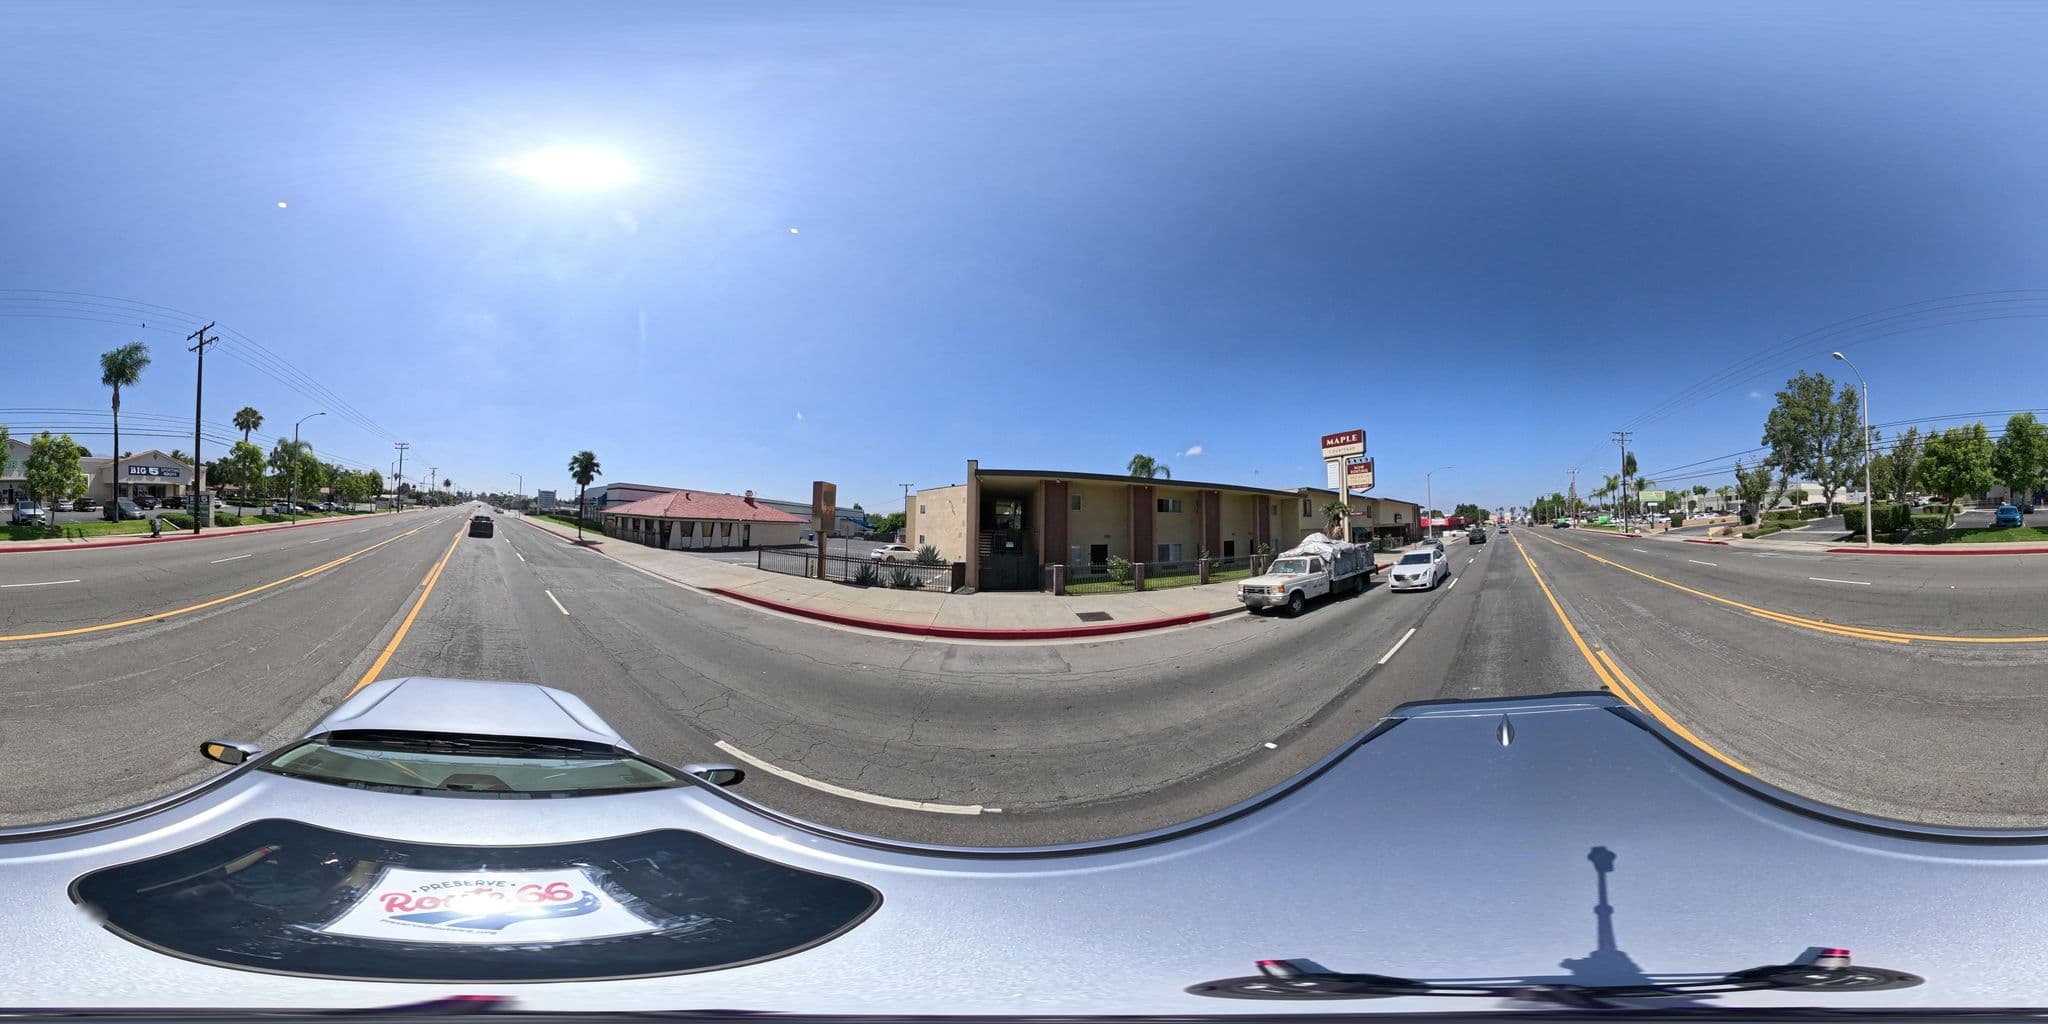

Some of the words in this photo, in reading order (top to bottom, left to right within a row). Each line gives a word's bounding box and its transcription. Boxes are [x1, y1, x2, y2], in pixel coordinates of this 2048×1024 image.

[1326, 434, 1358, 446] MAPLE
[130, 466, 146, 474] BIG
[149, 467, 159, 475] 5
[419, 880, 506, 892] PRESERVE
[516, 882, 574, 902] 66
